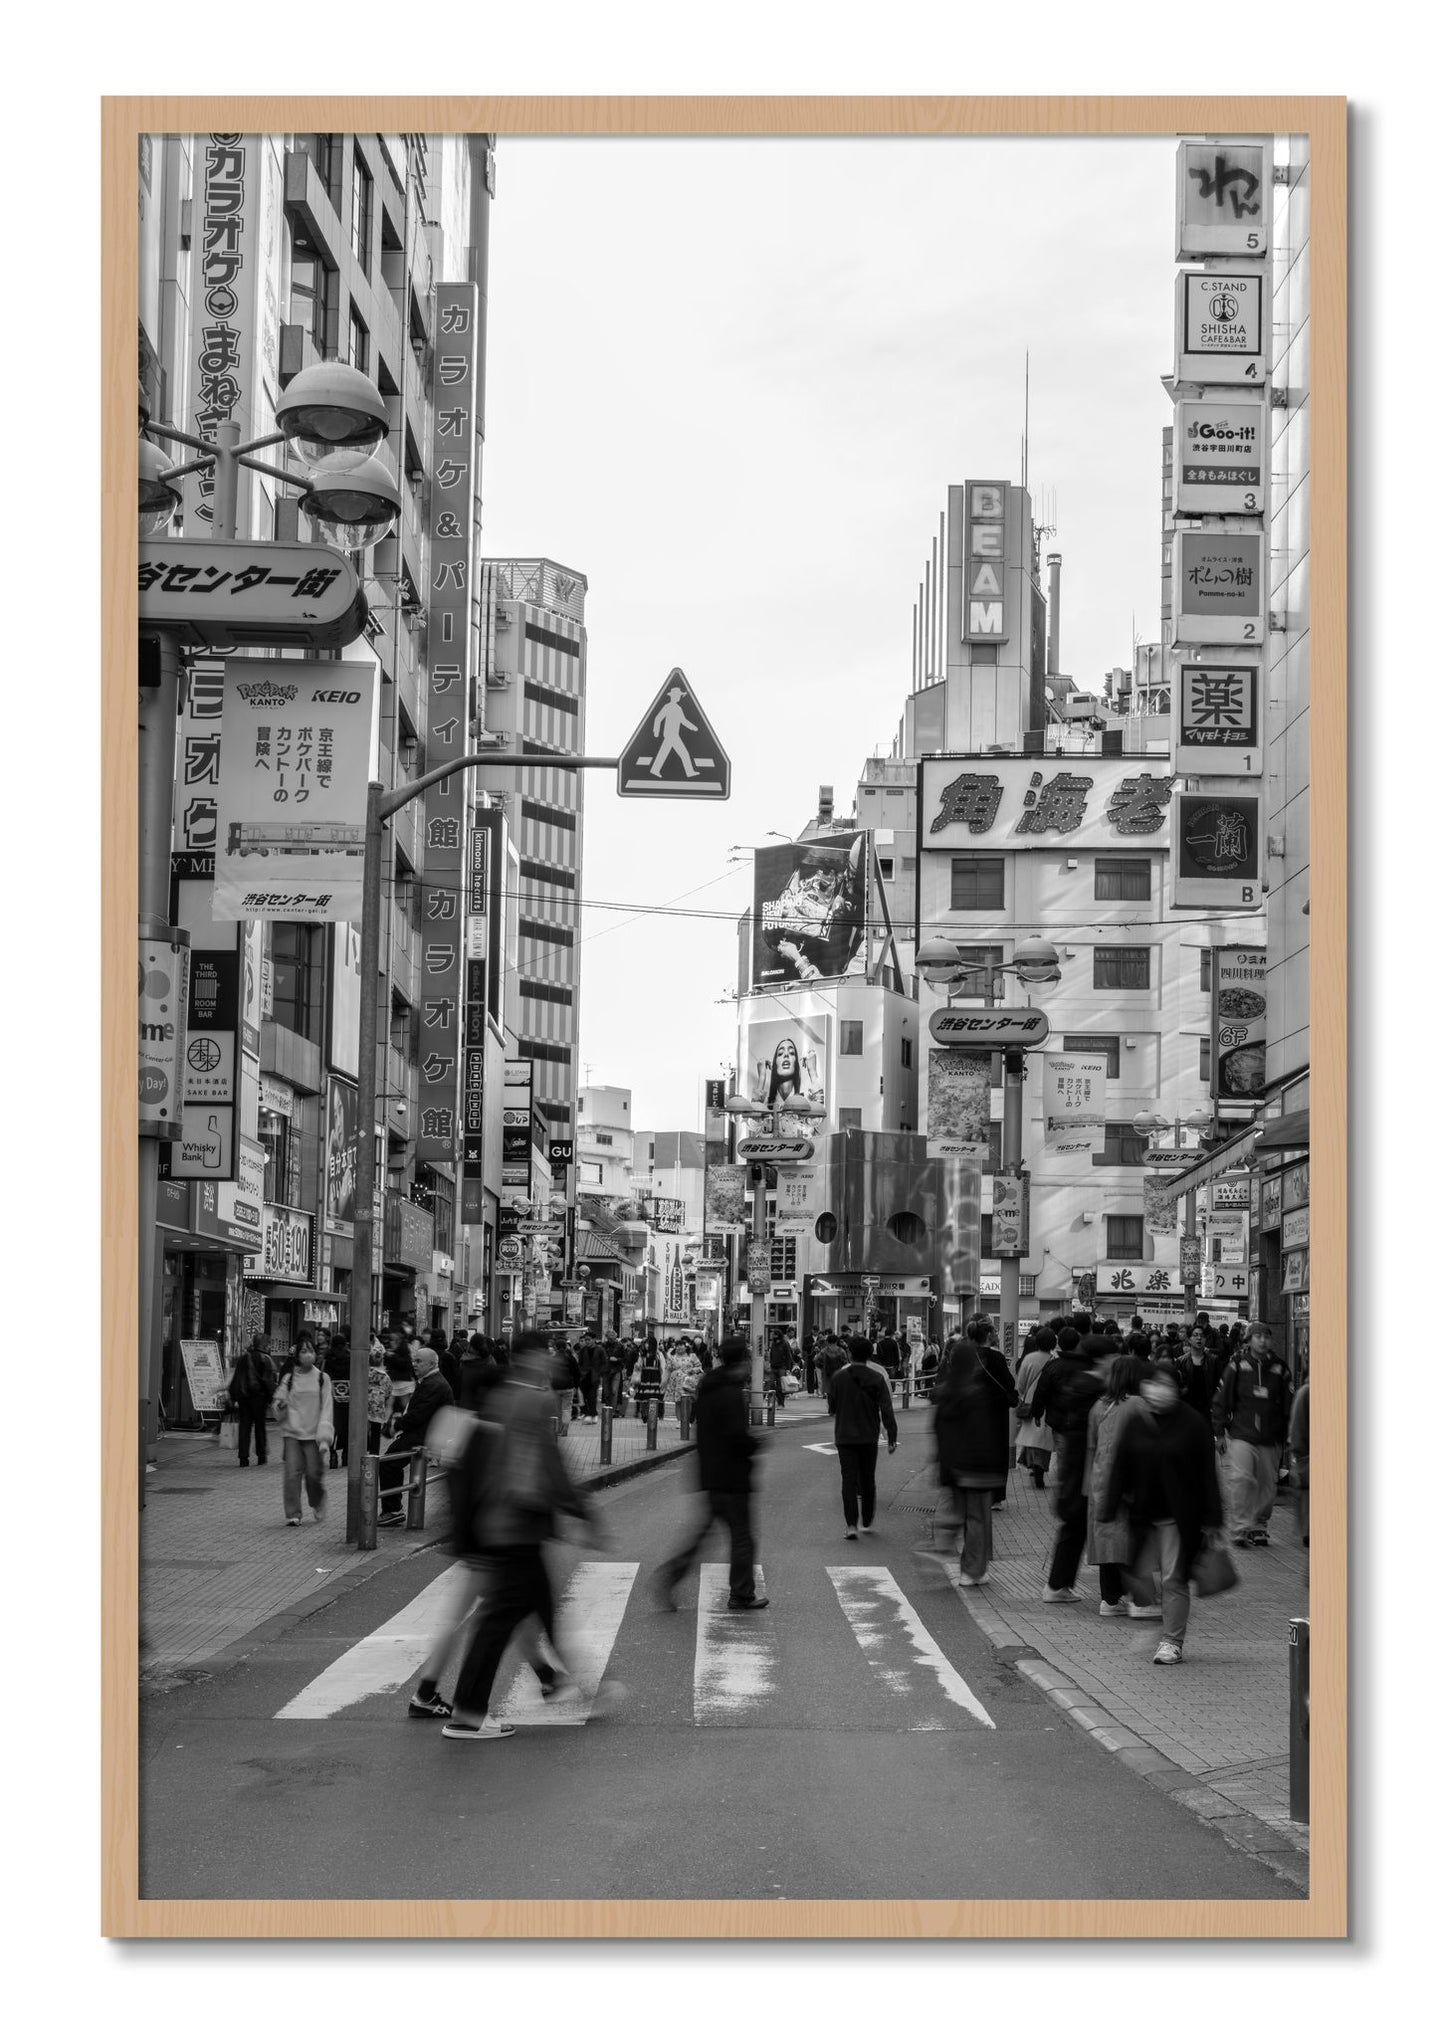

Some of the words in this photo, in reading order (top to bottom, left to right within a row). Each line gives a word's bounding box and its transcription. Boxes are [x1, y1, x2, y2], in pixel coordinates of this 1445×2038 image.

[203, 147, 245, 286] カラオケ
[1246, 233, 1259, 249] 5
[1201, 282, 1247, 292] C.STAND
[1201, 324, 1247, 334] SHISHA
[1201, 335, 1247, 343] CAFE&BAR
[1245, 363, 1257, 378] 4
[1200, 423, 1256, 440] Goo-it!
[1192, 444, 1252, 453] 渋谷宇田川町店
[1187, 469, 1257, 482] 全身もみほぐし
[1244, 493, 1257, 510] 3
[970, 485, 1004, 634] BEAM
[1199, 589, 1246, 598] Pomme-no-ki
[1244, 624, 1256, 639] 2
[250, 698, 286, 706] KANTO
[311, 690, 361, 704] KEIO
[1191, 673, 1243, 725] 薬
[1185, 728, 1249, 744] マツモトキヨシ
[254, 726, 271, 770] 冒険へ
[273, 726, 292, 803] カントーの
[294, 726, 313, 803] ポケパーク
[316, 727, 334, 789] 京王線で
[1243, 755, 1252, 771] 1
[930, 772, 1173, 834] 角海老
[474, 833, 484, 869] kimono
[242, 893, 333, 907] 渋谷センター街
[1242, 887, 1253, 903] B
[937, 1017, 1042, 1031] 渋谷センター街
[182, 1142, 217, 1154] Whisky
[551, 1146, 572, 1158] GU
[181, 1152, 203, 1161] Bank
[1111, 1268, 1172, 1291] 兆楽
[673, 1266, 682, 1311] BEER
